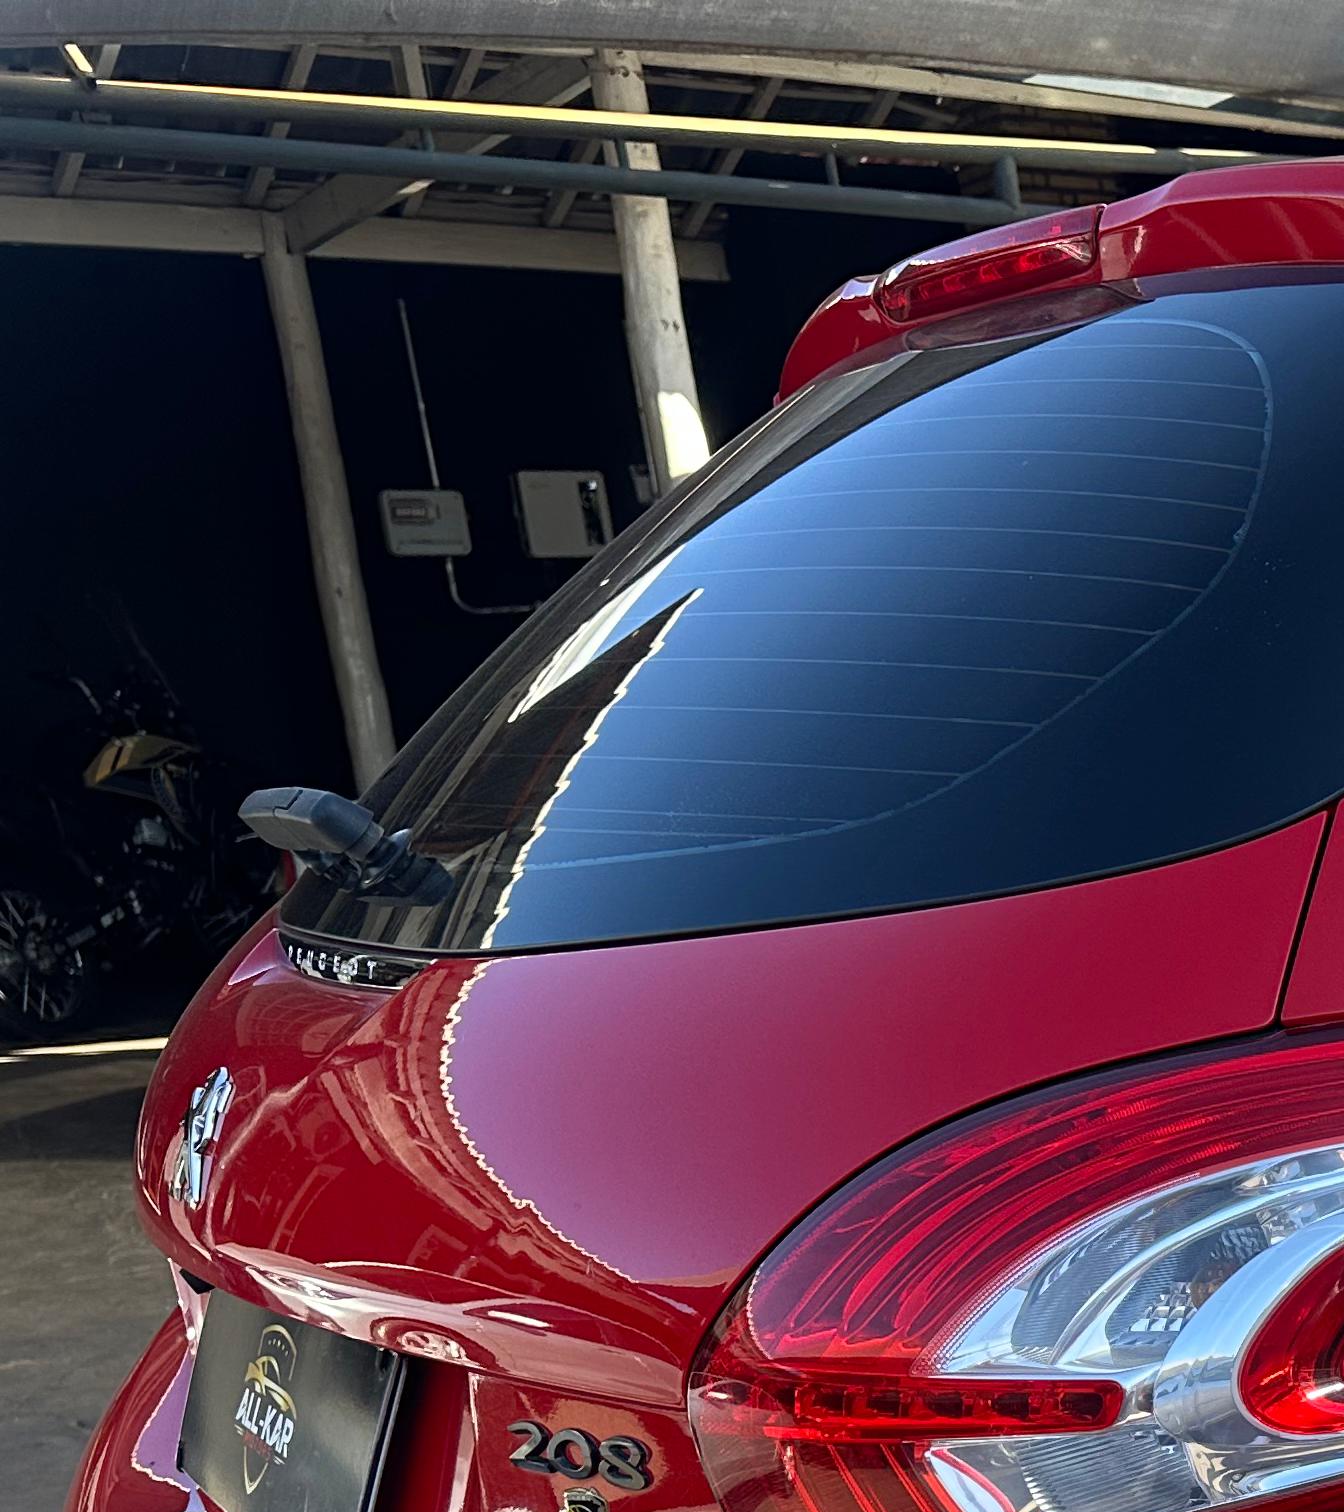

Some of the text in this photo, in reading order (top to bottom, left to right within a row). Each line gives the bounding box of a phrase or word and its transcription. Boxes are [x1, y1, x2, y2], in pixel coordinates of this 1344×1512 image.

[287, 944, 378, 980] PEUGEOT
[235, 1387, 295, 1459] ALL-KAR
[506, 1419, 655, 1491] 208
